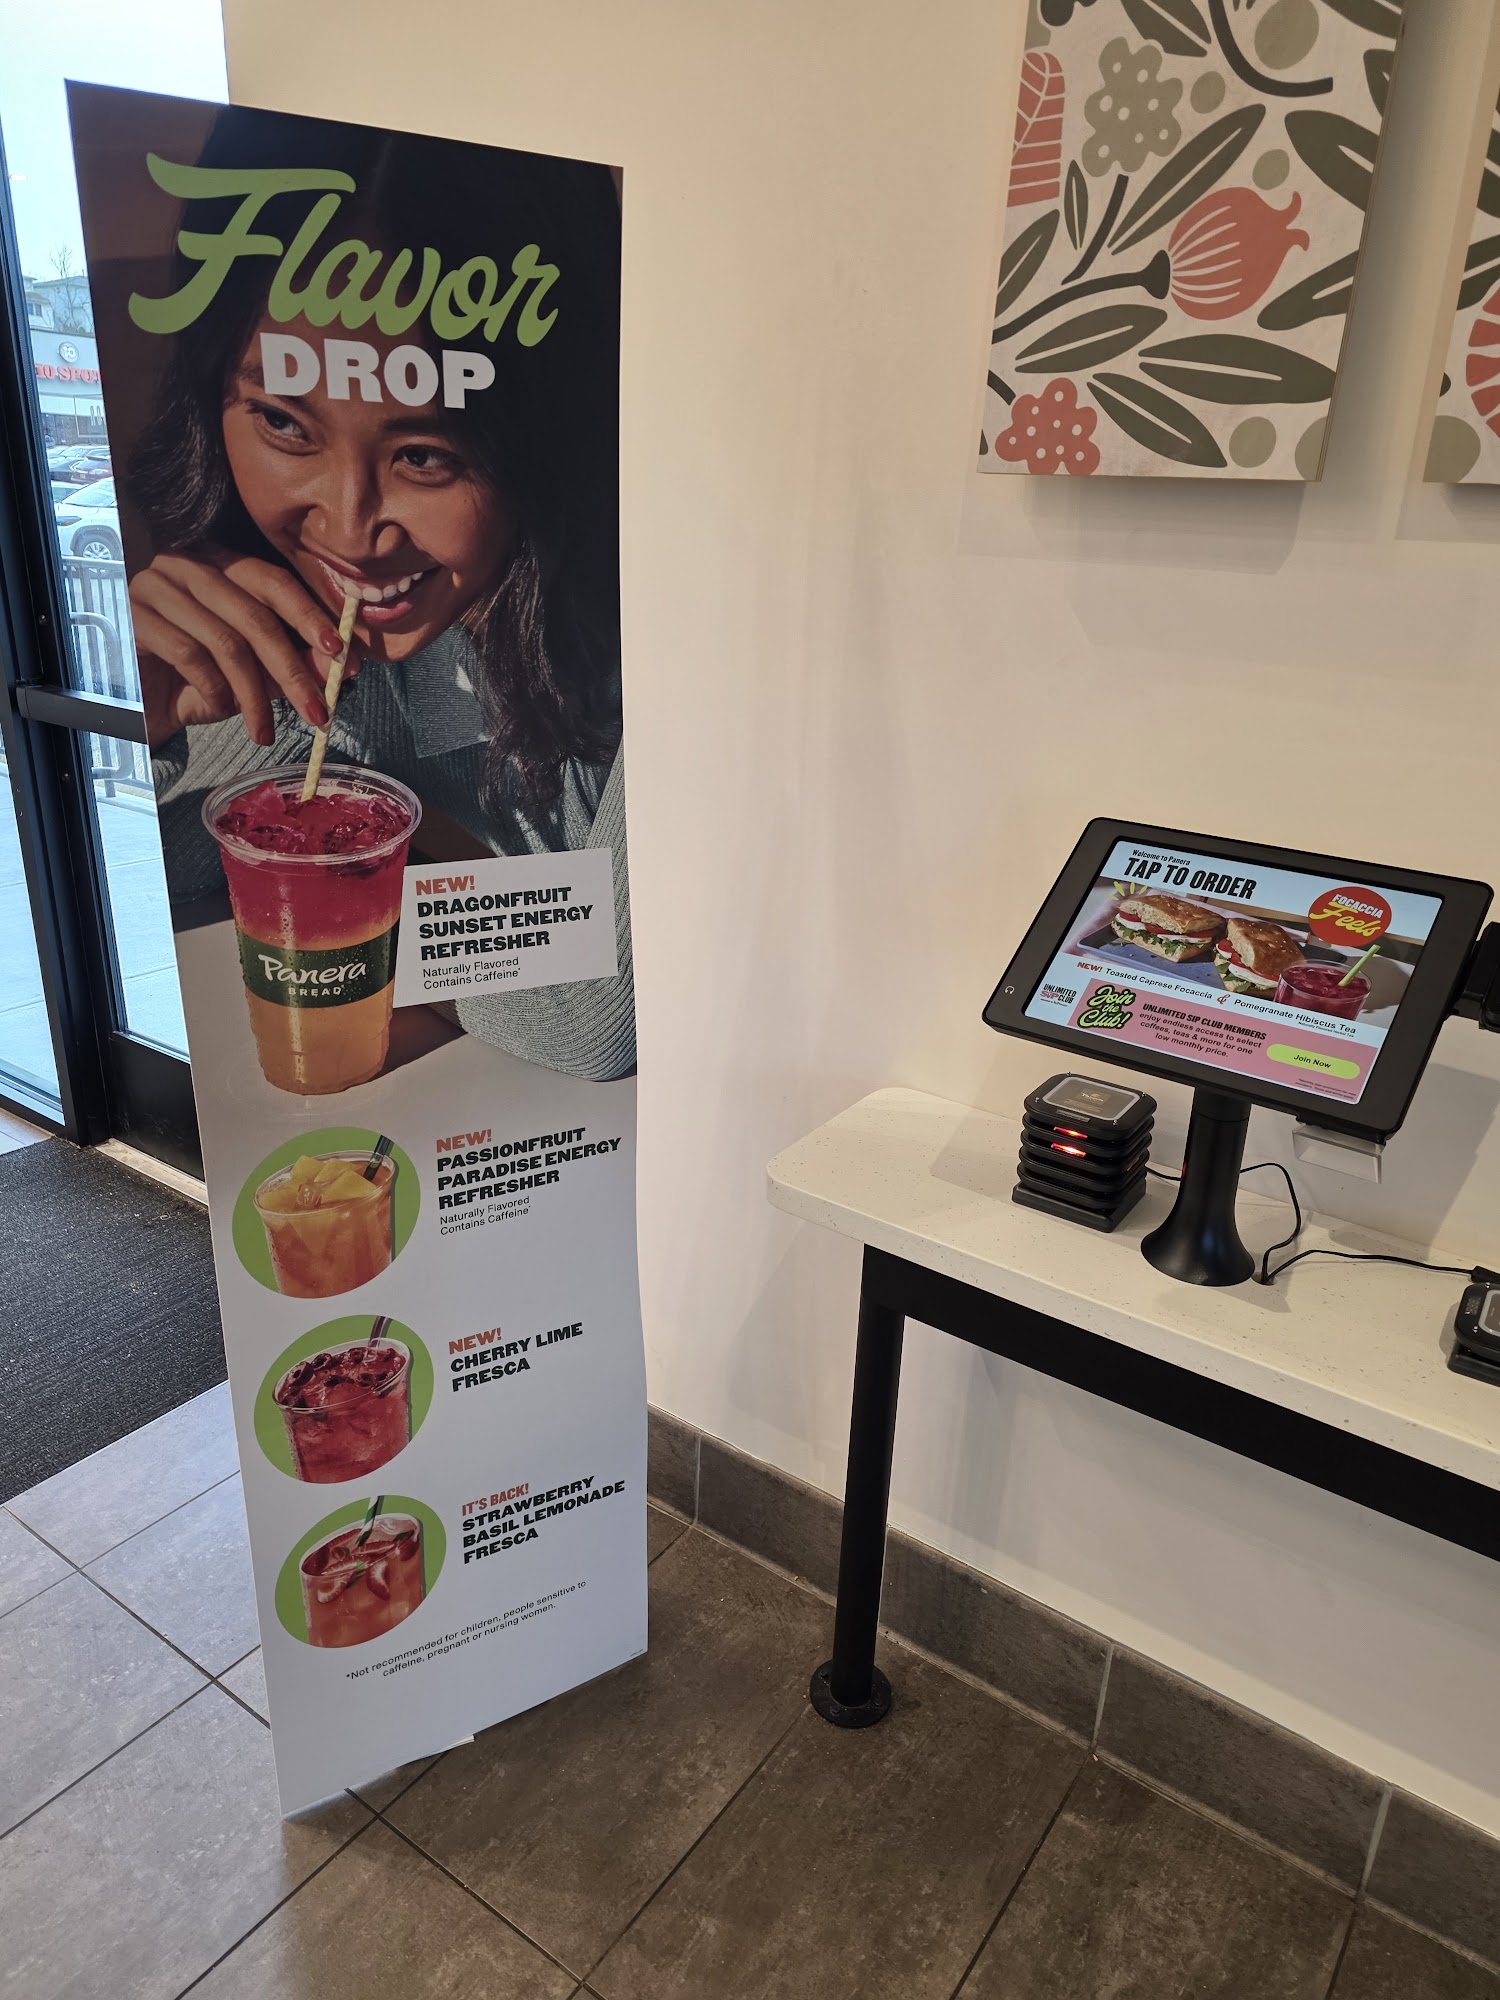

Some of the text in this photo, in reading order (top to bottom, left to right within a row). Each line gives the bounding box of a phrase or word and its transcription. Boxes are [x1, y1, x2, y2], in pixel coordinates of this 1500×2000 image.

[128, 152, 560, 347] Flavor
[260, 332, 496, 409] DROP
[1132, 849, 1159, 860] Welcome
[1169, 856, 1190, 865] Panera
[416, 876, 475, 895] NEW!
[1124, 858, 1256, 899] TAP TO ORDER
[418, 887, 571, 917] DRAGONFRUIT
[1332, 894, 1383, 918] FOCACCIA
[420, 905, 593, 938] SUNSET ENERGY
[1309, 901, 1381, 937] Feels
[421, 931, 550, 960] REFRESHER
[258, 954, 366, 984] Panera
[423, 957, 518, 978] Naturally Flavored
[424, 974, 471, 990] Contains
[1044, 983, 1076, 997] UNLIMITED
[1058, 995, 1074, 1003] CLUB
[1077, 961, 1356, 1034] NEW! Toasted Caprese Focaccia & Pomegranate Hibiscus Tea
[1088, 986, 1134, 1006] Join
[1080, 1009, 1130, 1028] Club!
[1102, 1003, 1119, 1012] the
[1143, 1003, 1267, 1040] UNLIMITED SIP CLUB MEMBERS
[1140, 1013, 1161, 1022] enjoy
[1163, 1018, 1193, 1030] endless
[1195, 1027, 1223, 1039] access
[1236, 1037, 1262, 1048] select
[1140, 1021, 1171, 1034] coffees,
[1173, 1029, 1190, 1038] teas
[1200, 1038, 1220, 1046] more
[1223, 1042, 1236, 1050] for
[1237, 1047, 1253, 1055] one
[1155, 1033, 1228, 1057] low monthly price.
[1294, 1055, 1331, 1068] Join Now
[436, 1129, 492, 1153] NEW!
[438, 1127, 585, 1172] PASSIONFRUIT
[438, 1137, 621, 1191] PARADISE ENERGY
[439, 1170, 560, 1210] REFRESHER
[440, 1196, 530, 1224] Naturally Flavored
[440, 1219, 485, 1235] Contains
[448, 1327, 501, 1354] NEW!
[451, 1322, 582, 1372] CHERRY LIME
[452, 1358, 530, 1392] FRESCA
[462, 1476, 594, 1531] STRAWBERRY
[490, 1483, 529, 1507] BACK!
[463, 1480, 625, 1548] BASIL LEMONADE
[464, 1528, 538, 1564] FRESCA
[372, 1637, 442, 1671] recommended
[445, 1632, 458, 1642] for
[461, 1616, 500, 1636] children,
[504, 1602, 534, 1619] people
[537, 1584, 575, 1605] sensitive
[578, 1581, 586, 1589] to
[383, 1603, 556, 1677] caffeine, pregnant or nursing women.
